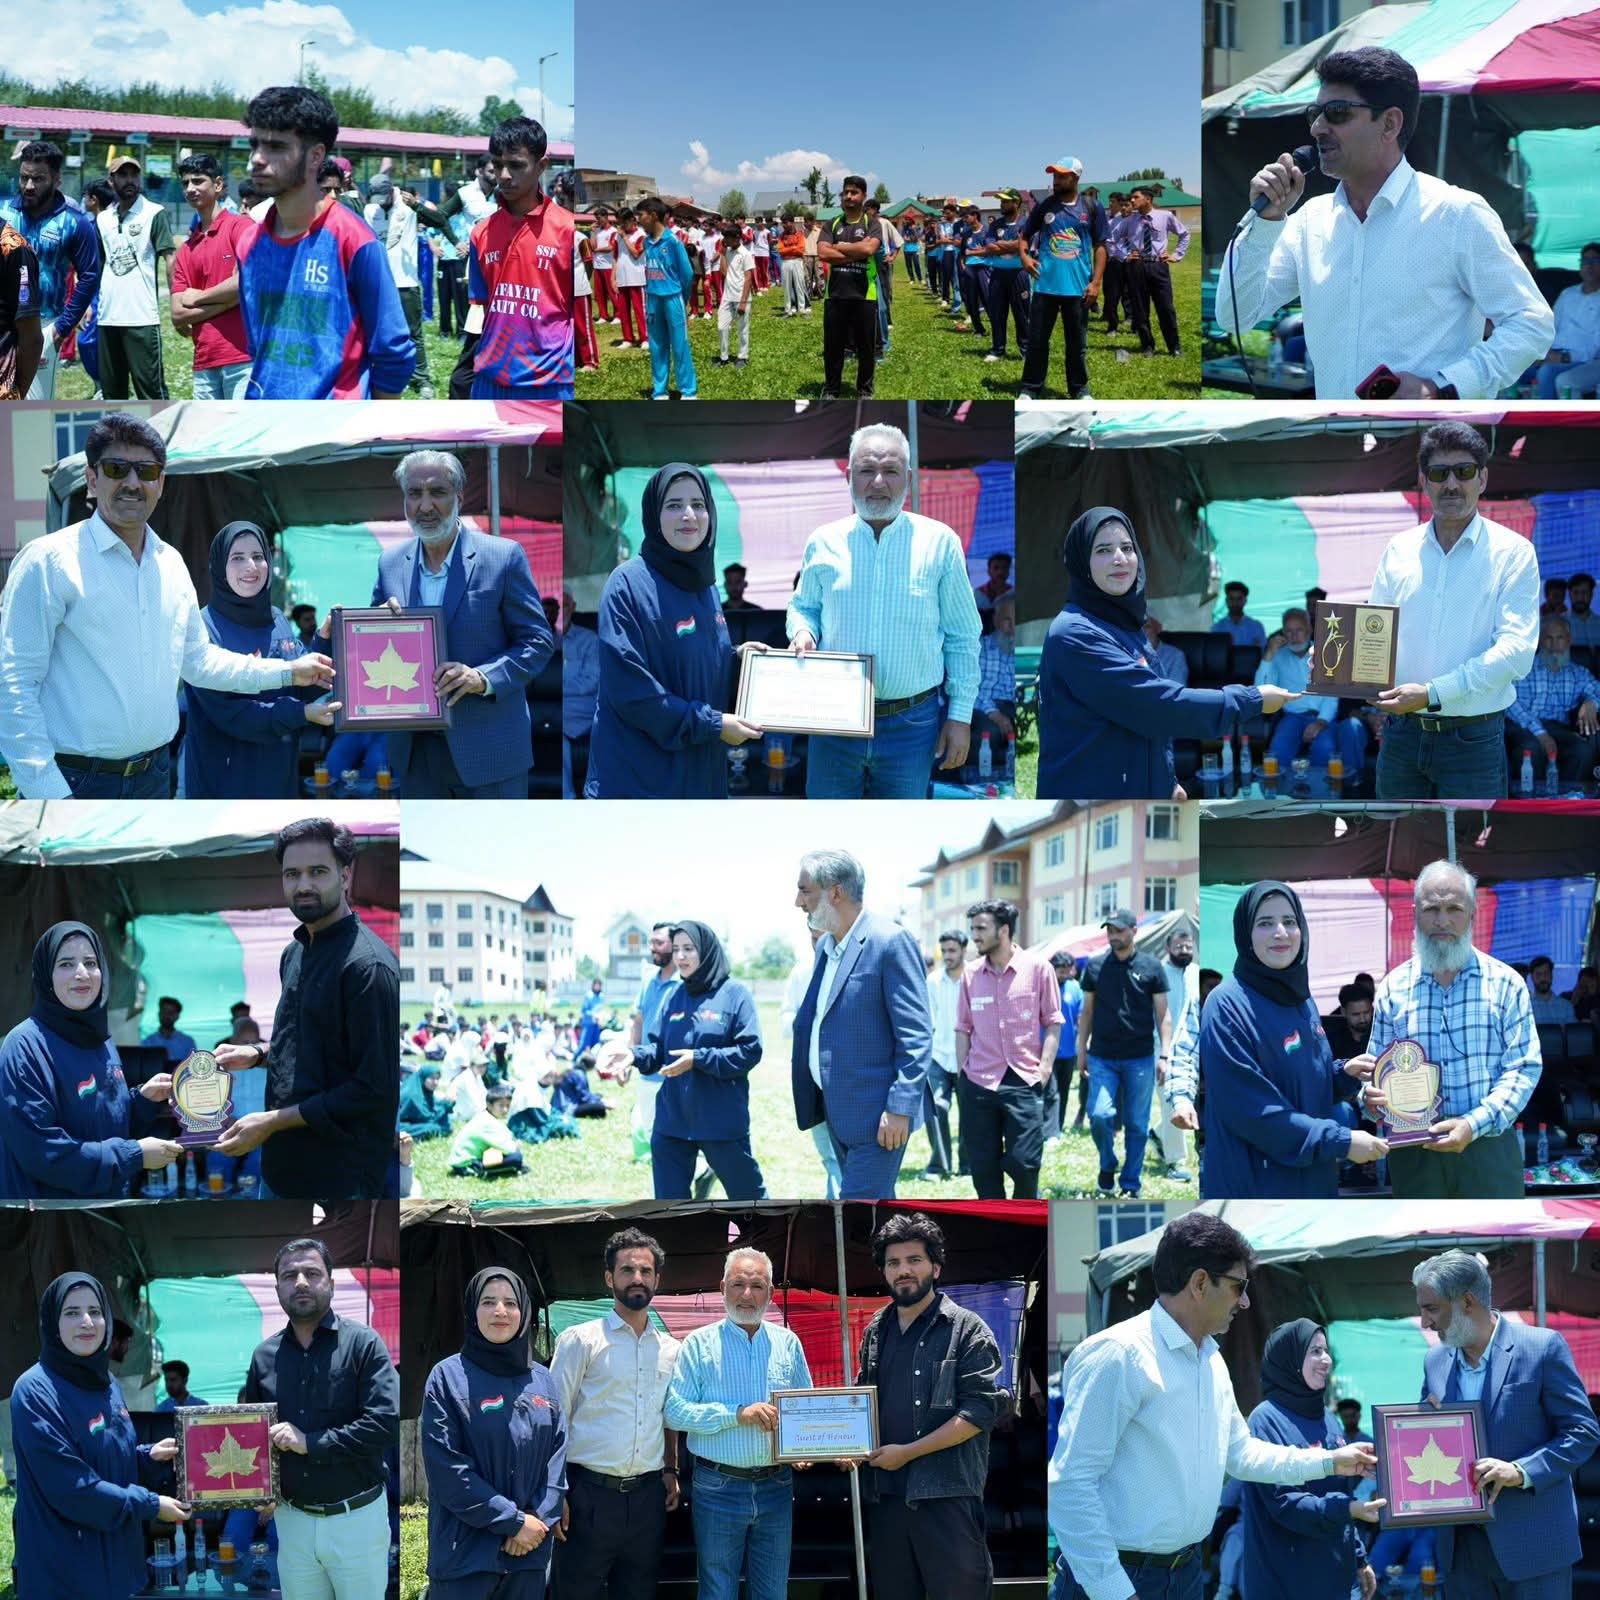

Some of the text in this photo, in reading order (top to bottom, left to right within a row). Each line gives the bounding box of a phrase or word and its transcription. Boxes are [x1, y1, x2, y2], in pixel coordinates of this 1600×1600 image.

[484, 250, 500, 265] KFC
[536, 244, 557, 258] SSF
[304, 258, 329, 284] HS
[494, 282, 541, 302] IFAYAT
[489, 299, 542, 320] RUIT CO.
